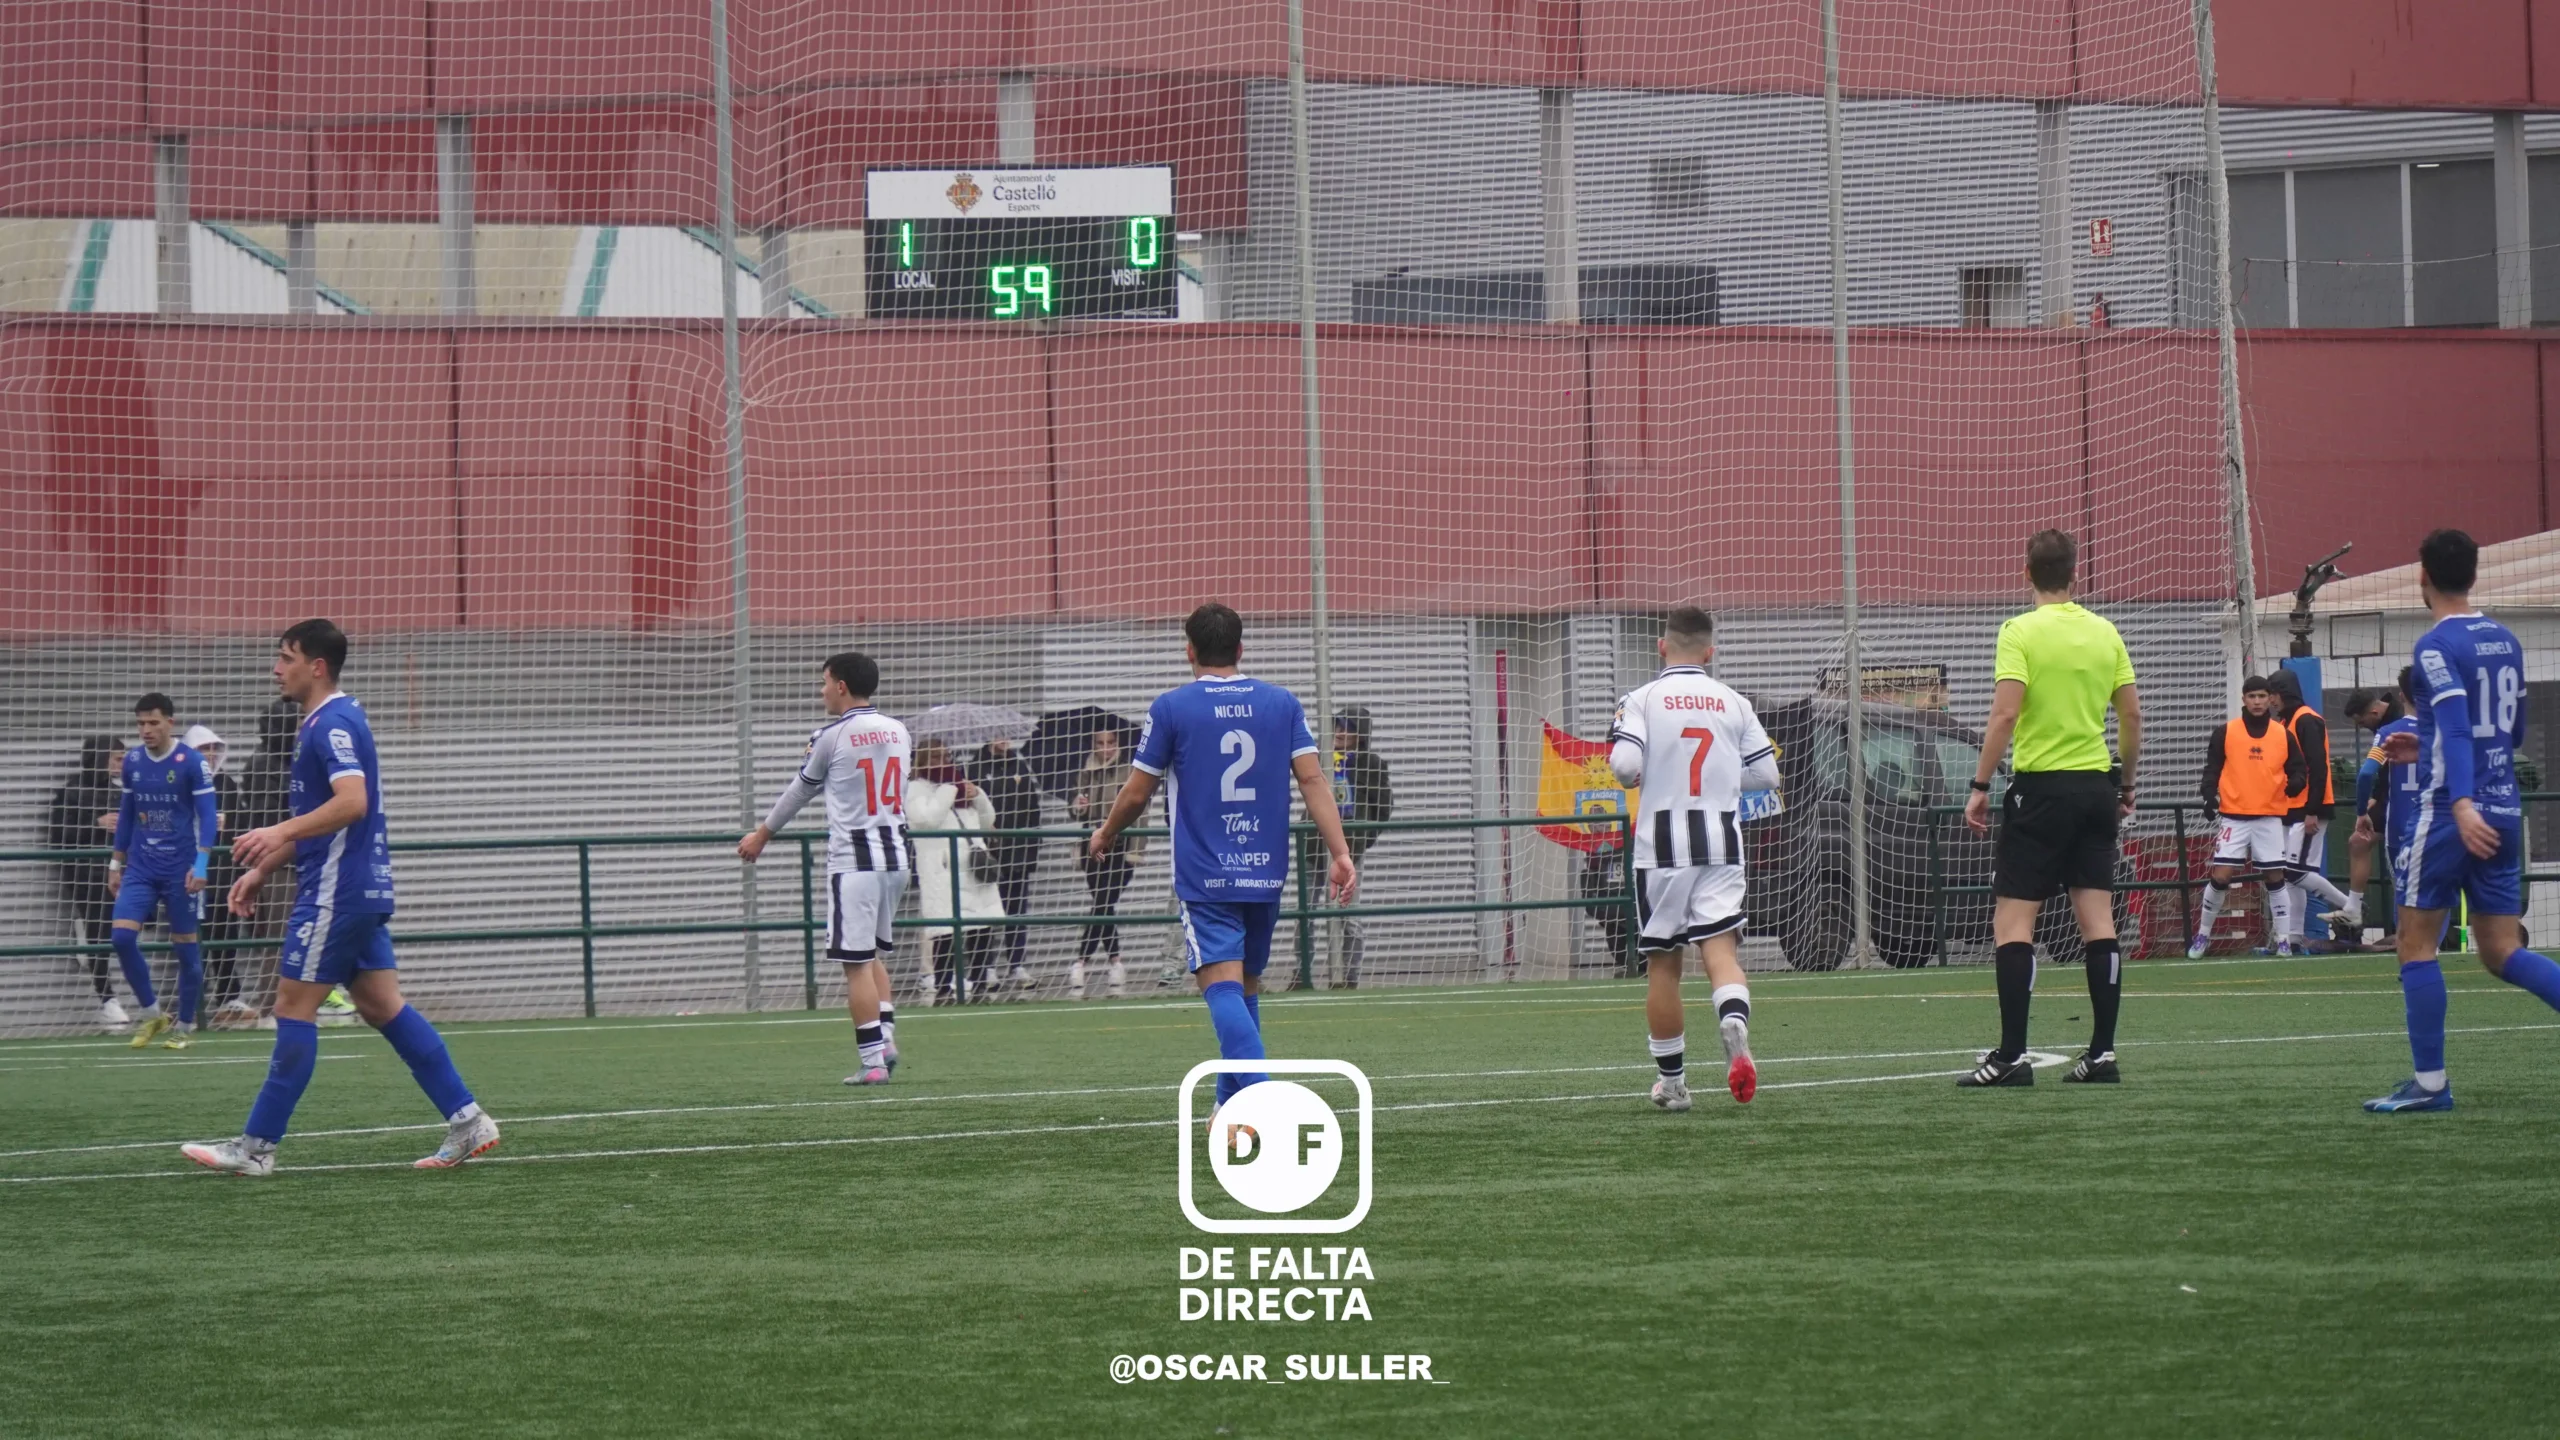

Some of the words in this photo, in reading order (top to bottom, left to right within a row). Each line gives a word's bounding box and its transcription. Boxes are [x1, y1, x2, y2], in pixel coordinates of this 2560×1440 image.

[993, 174, 1042, 183] Ajuntament
[1045, 173, 1055, 182] de
[993, 184, 1056, 201] Castelló
[1008, 203, 1040, 213] Esports
[902, 223, 910, 266] 1
[1131, 217, 1156, 265] 0
[895, 271, 935, 288] LOCAL
[1112, 269, 1145, 286] VISIT.
[992, 266, 1050, 314] 59
[1663, 695, 1726, 713] SEGURA
[2472, 665, 2519, 738] 18
[1214, 704, 1253, 719] NICOLI
[850, 731, 890, 748] ENRIC
[1220, 729, 1257, 802] 2
[1680, 727, 1715, 797] 7
[855, 756, 902, 817] 14
[1221, 812, 1260, 834] Tim's
[1217, 852, 1270, 866] CANPEP
[1204, 879, 1226, 888] VISIT
